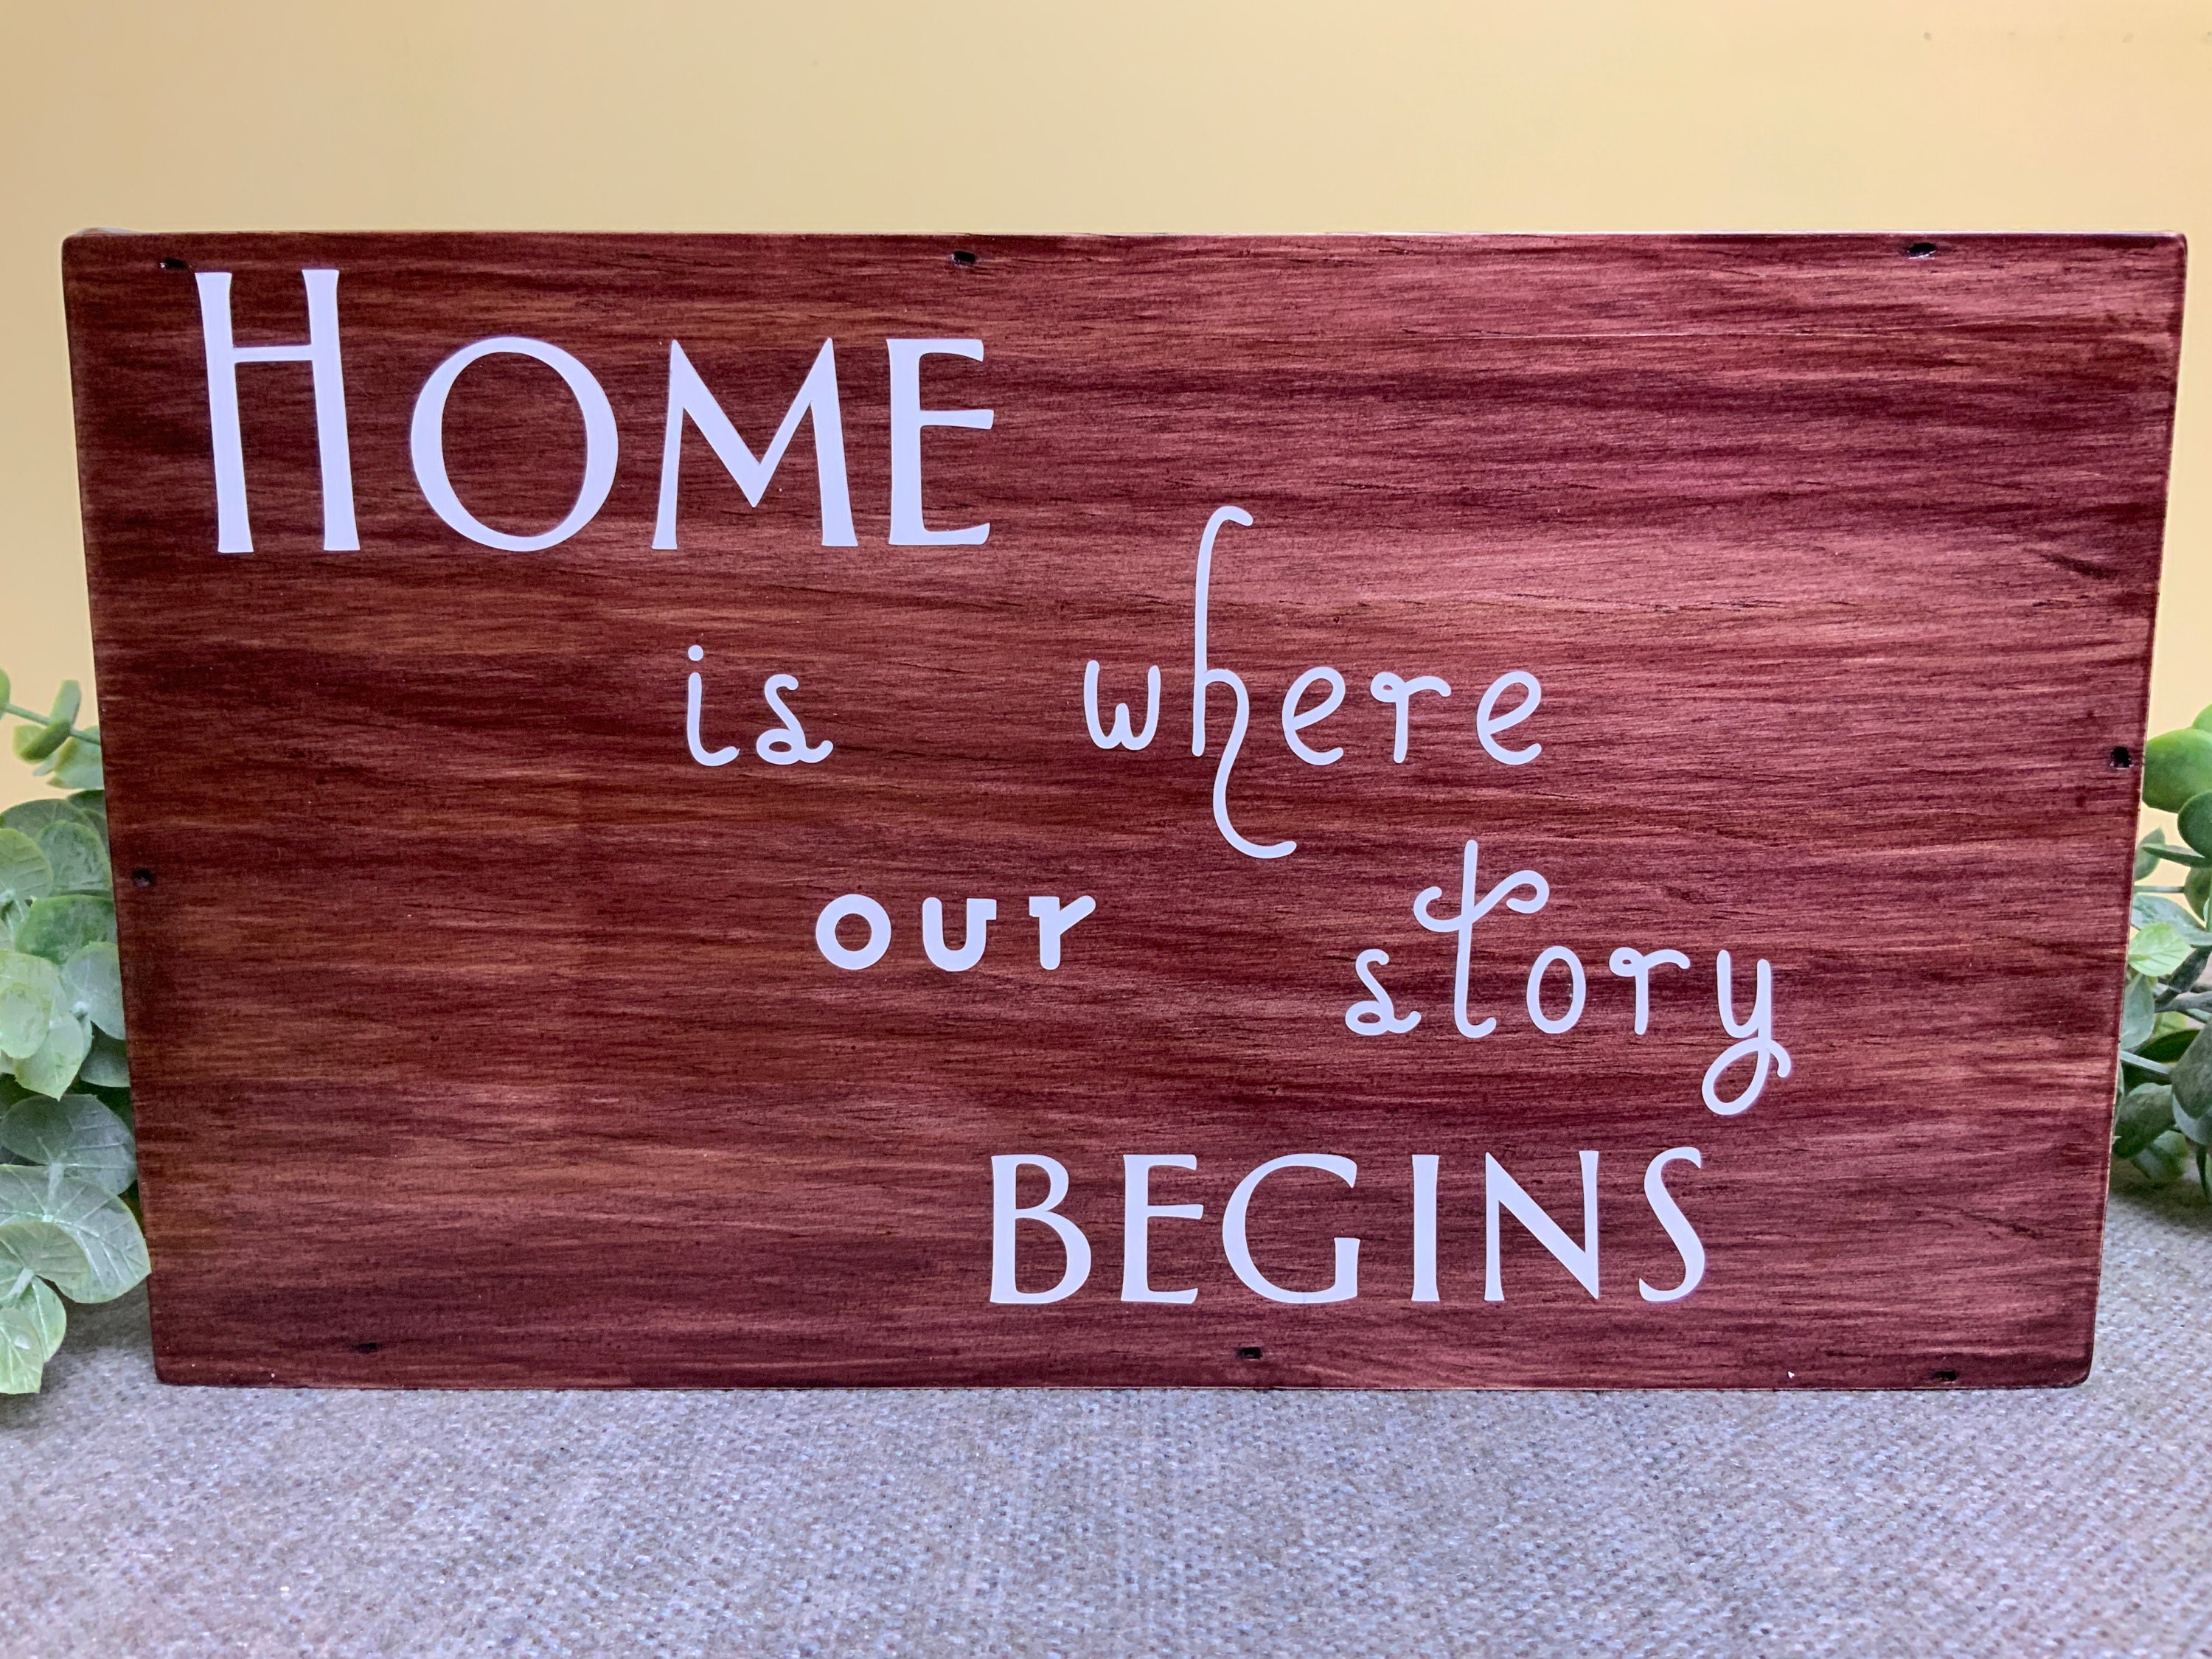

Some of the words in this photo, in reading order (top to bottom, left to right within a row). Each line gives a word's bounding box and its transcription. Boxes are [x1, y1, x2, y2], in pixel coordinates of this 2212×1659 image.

[194, 268, 995, 554] HOME
[686, 644, 835, 768] is
[1083, 505, 1543, 860] where
[815, 893, 1097, 973] our
[1344, 838, 1792, 1116] story
[989, 1146, 1708, 1305] BEGINS
